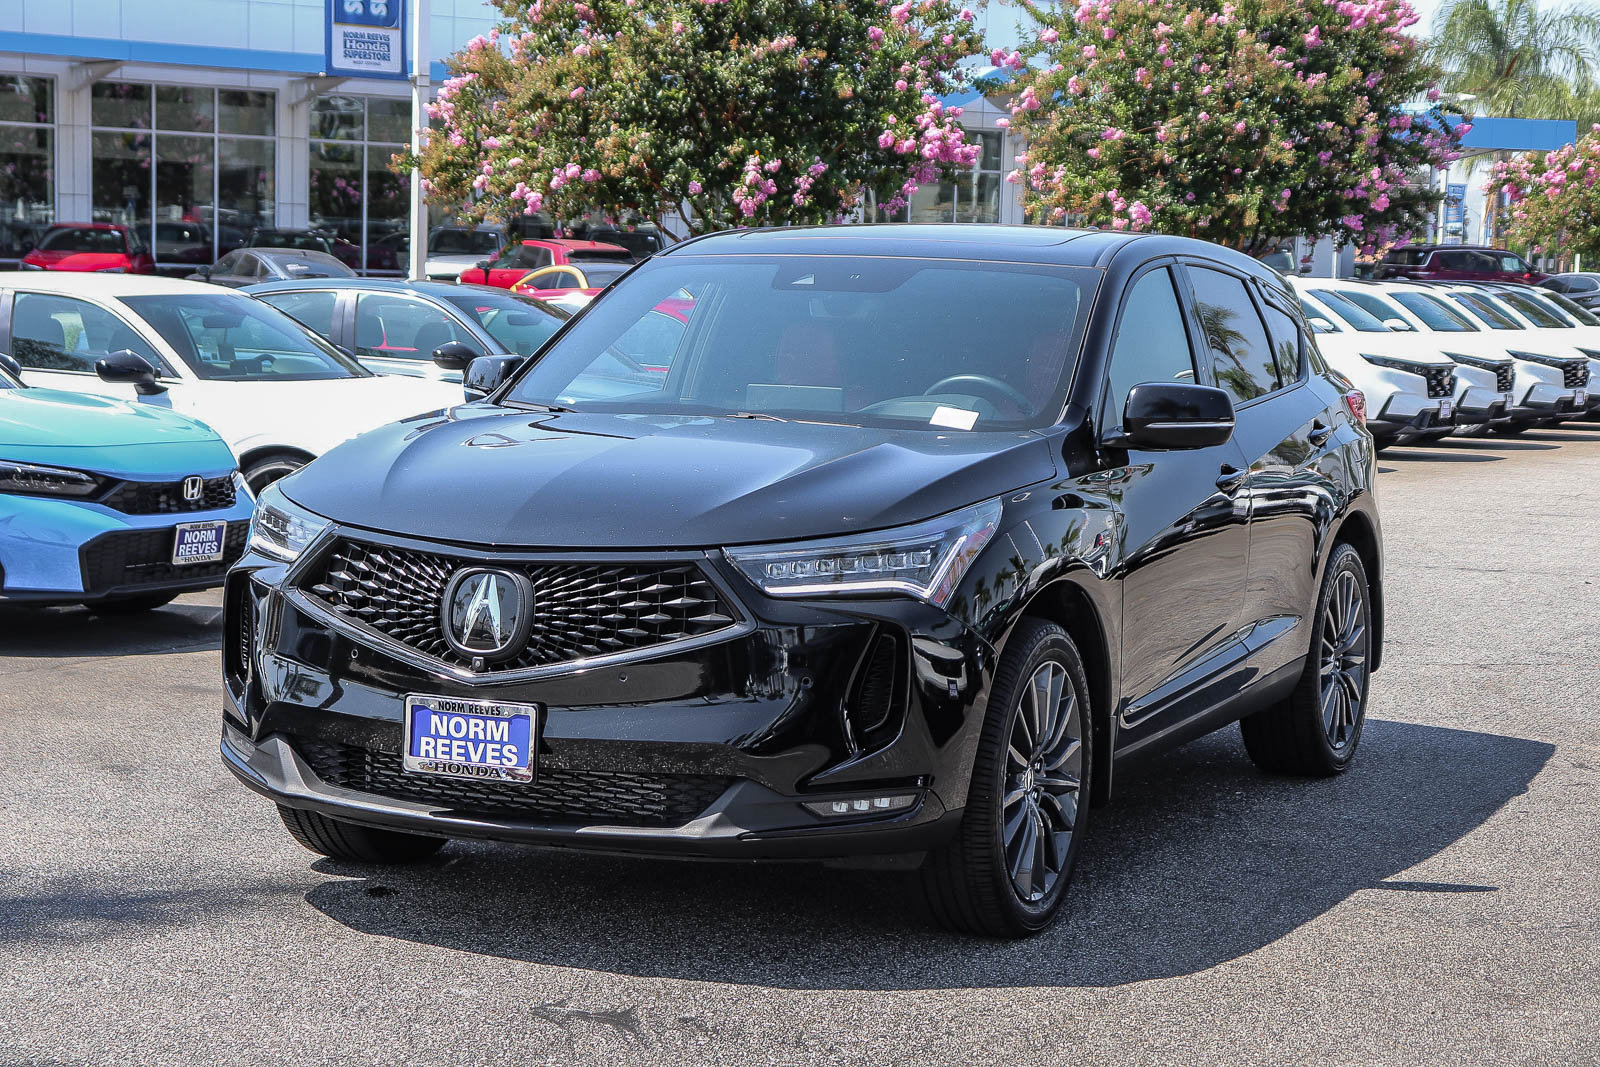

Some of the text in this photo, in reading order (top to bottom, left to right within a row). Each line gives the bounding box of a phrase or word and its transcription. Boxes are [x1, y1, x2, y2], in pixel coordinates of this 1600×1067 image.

[343, 31, 366, 39] NORM
[346, 39, 388, 51] Honda
[344, 50, 390, 61] SUPERSTORE
[184, 530, 216, 543] NORM
[179, 542, 218, 555] REEVES
[438, 701, 500, 716] NORM REEVES
[430, 715, 508, 742] NORM
[420, 737, 518, 766] REEVES
[434, 763, 501, 778] HONDA
